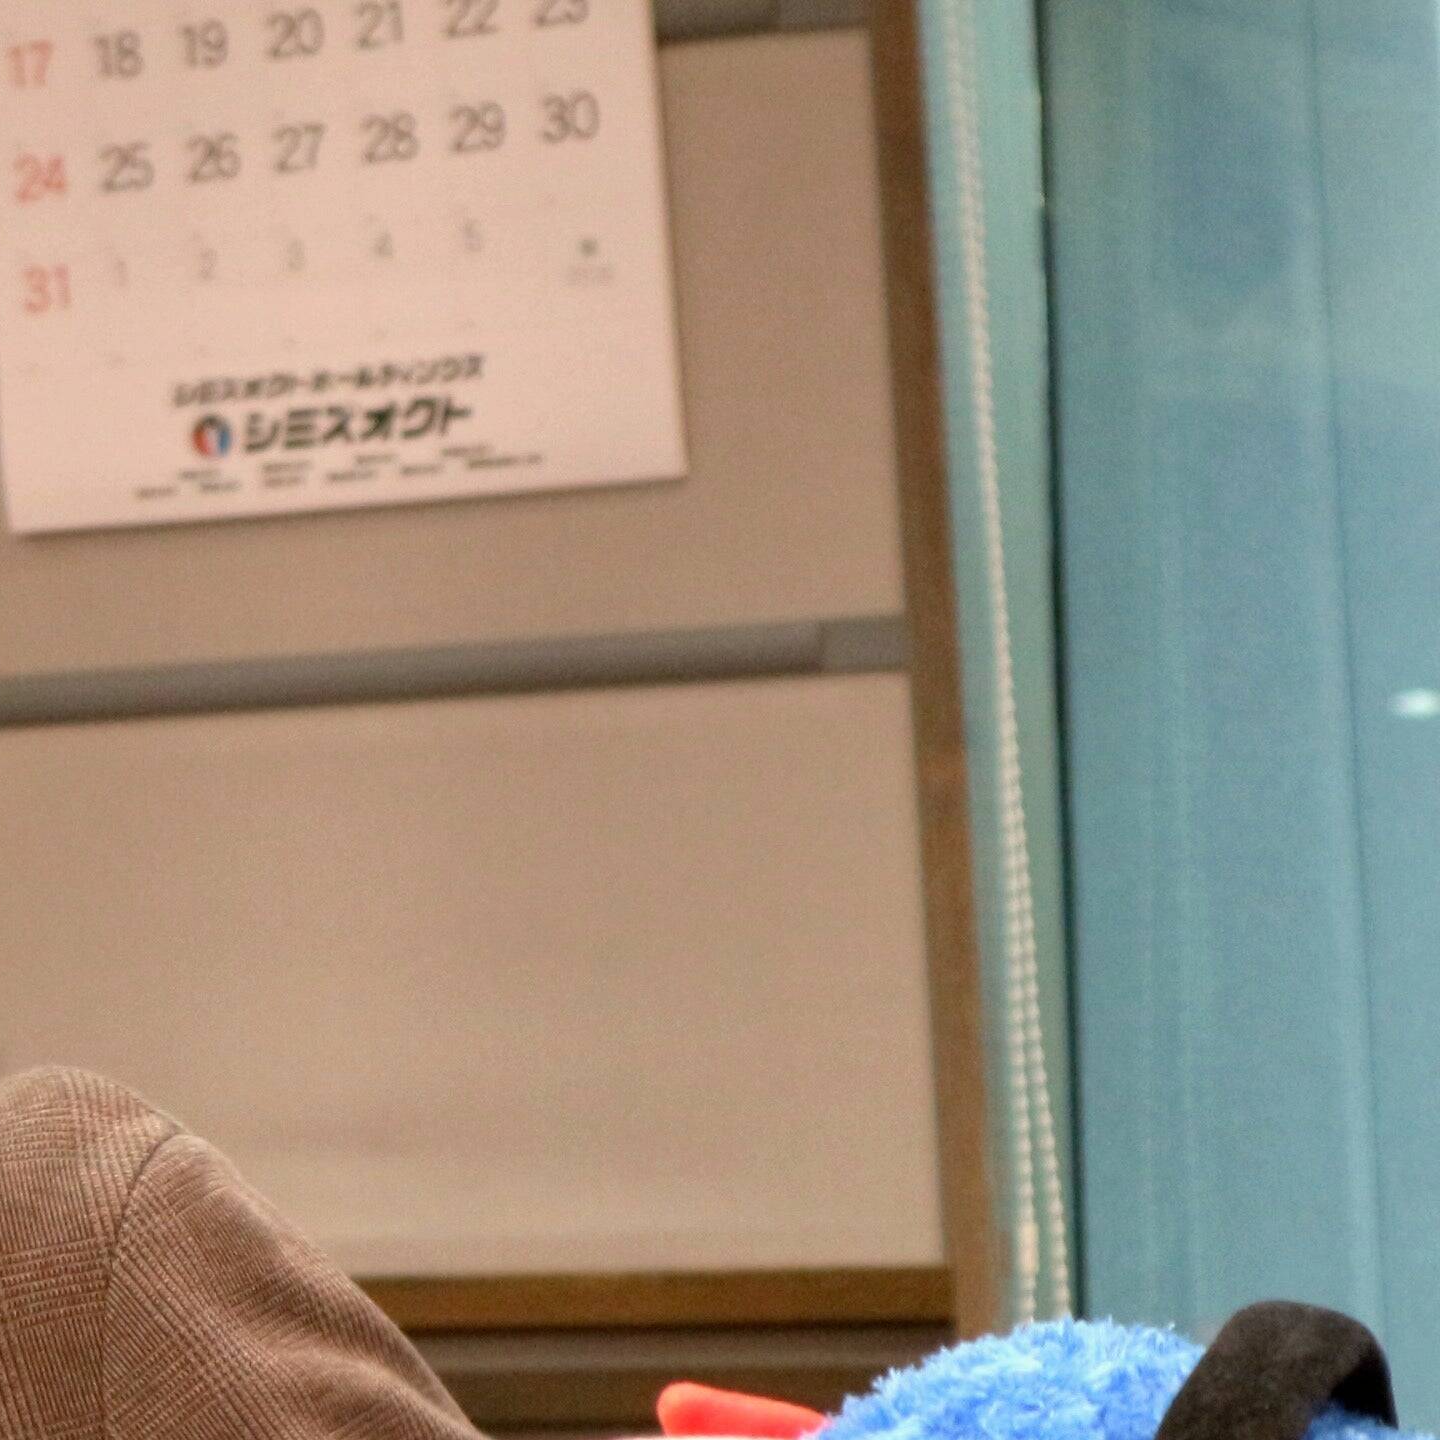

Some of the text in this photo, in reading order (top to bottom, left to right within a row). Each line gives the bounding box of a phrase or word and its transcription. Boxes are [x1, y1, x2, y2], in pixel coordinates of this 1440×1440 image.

[6, 38, 54, 89] 17
[93, 29, 144, 80] 18
[182, 19, 228, 69] 19
[266, 7, 325, 60] 20
[354, 0, 405, 49] 21
[440, 0, 500, 39] 22
[13, 88, 600, 203] 24 25 26 27 28 29 30
[22, 262, 72, 314] 31
